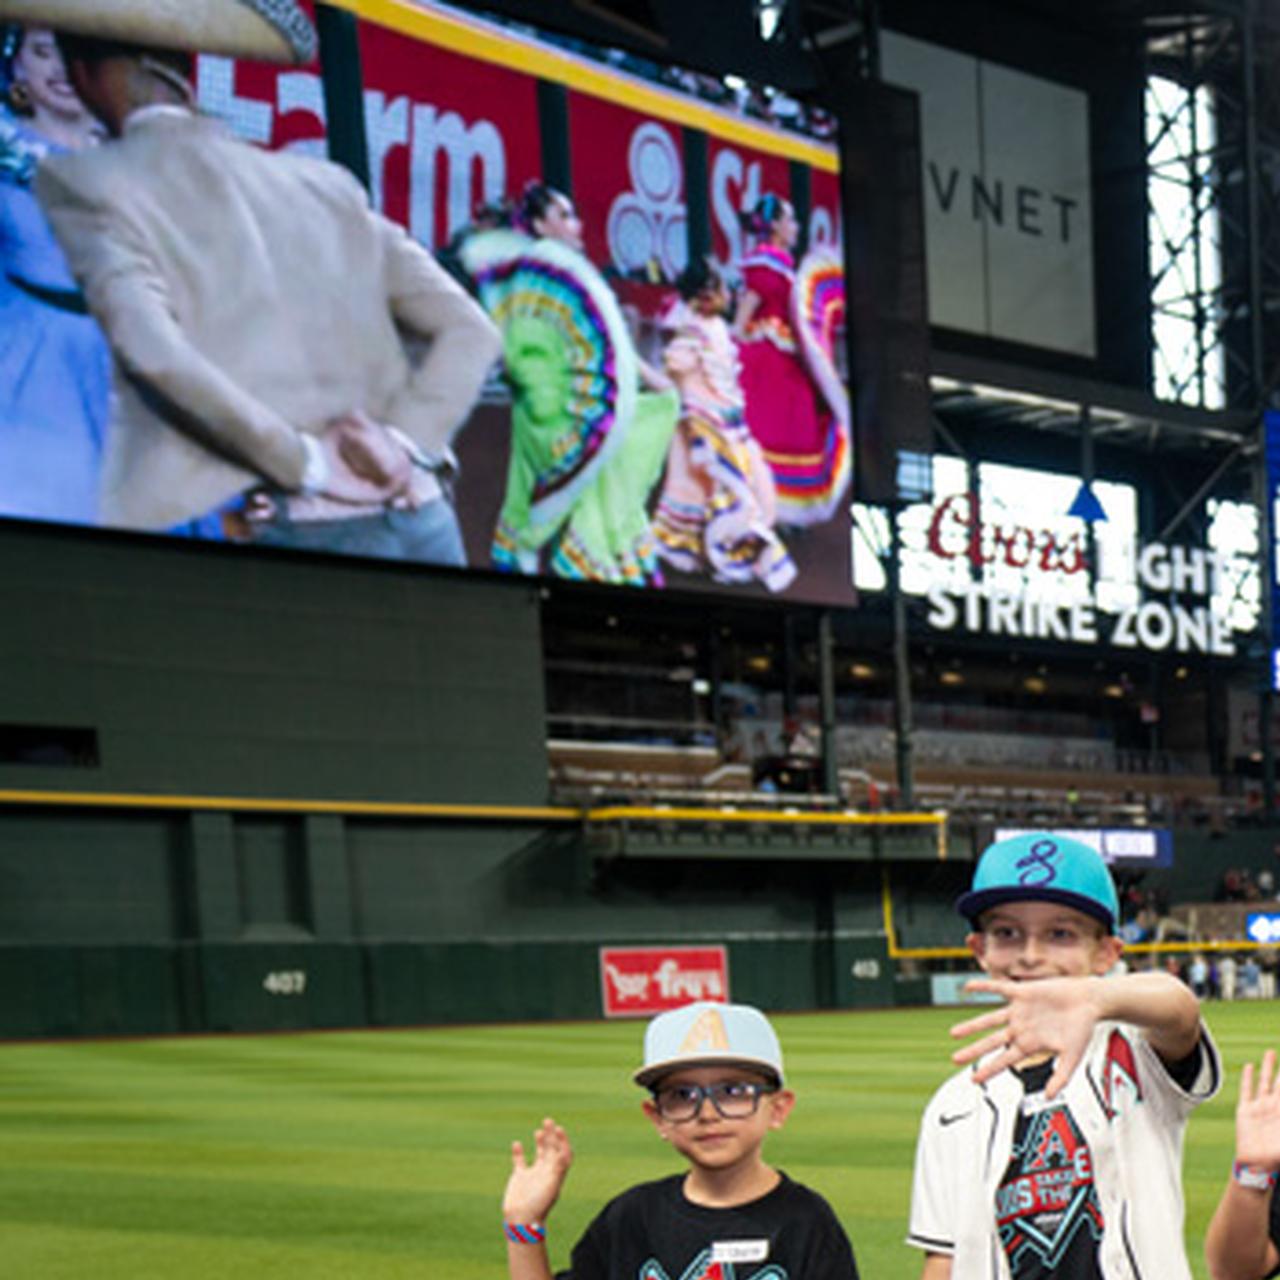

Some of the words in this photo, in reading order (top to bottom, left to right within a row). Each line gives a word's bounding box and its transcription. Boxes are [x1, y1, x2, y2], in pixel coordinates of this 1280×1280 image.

[927, 583, 1098, 643] STRIKE
[1110, 603, 1237, 655] ZONE
[263, 970, 306, 995] 407
